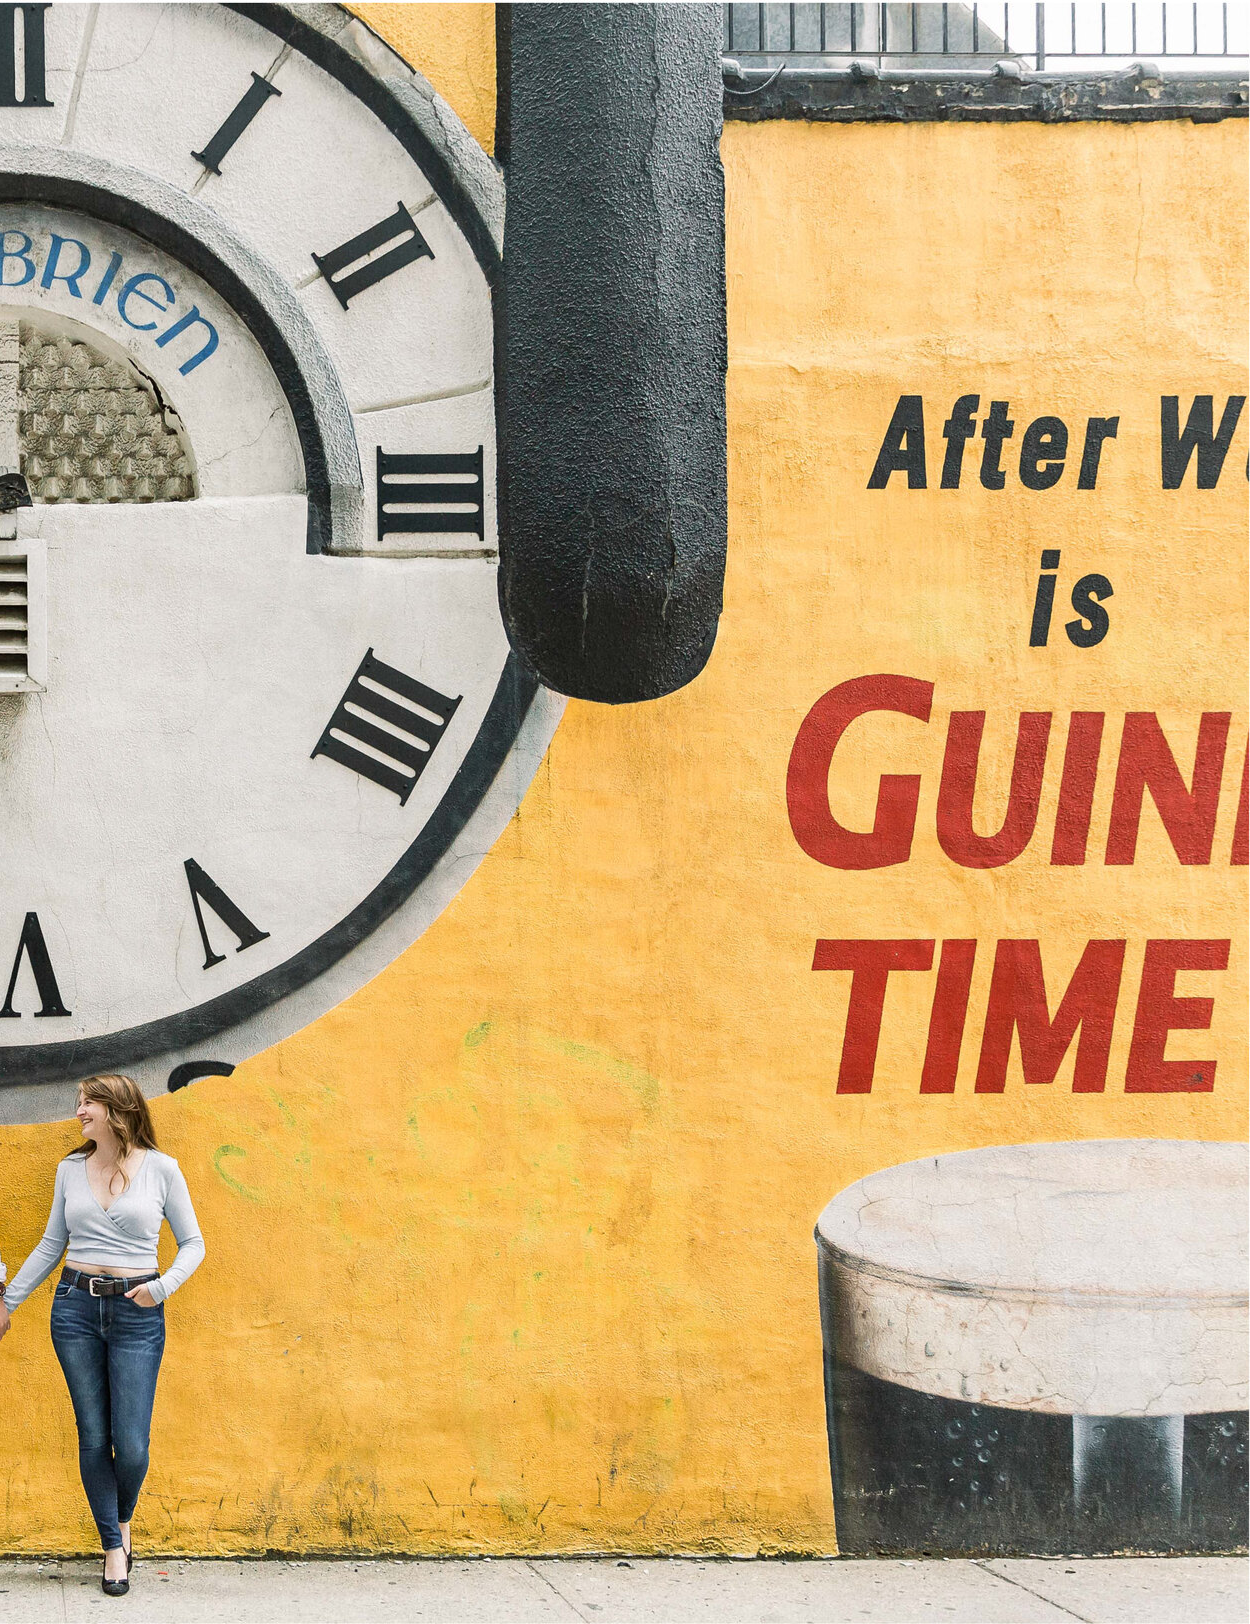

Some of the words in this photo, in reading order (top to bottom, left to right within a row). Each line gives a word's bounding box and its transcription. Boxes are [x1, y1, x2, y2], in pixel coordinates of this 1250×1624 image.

[190, 71, 282, 176] I
[311, 201, 435, 311] II
[377, 445, 484, 541] III
[866, 394, 1120, 490] After
[1160, 395, 1248, 490] W
[1029, 549, 1114, 648] is
[310, 647, 463, 807] IIII
[786, 673, 1248, 871] GUIN
[184, 857, 270, 970] V
[811, 938, 1231, 1095] TIME
